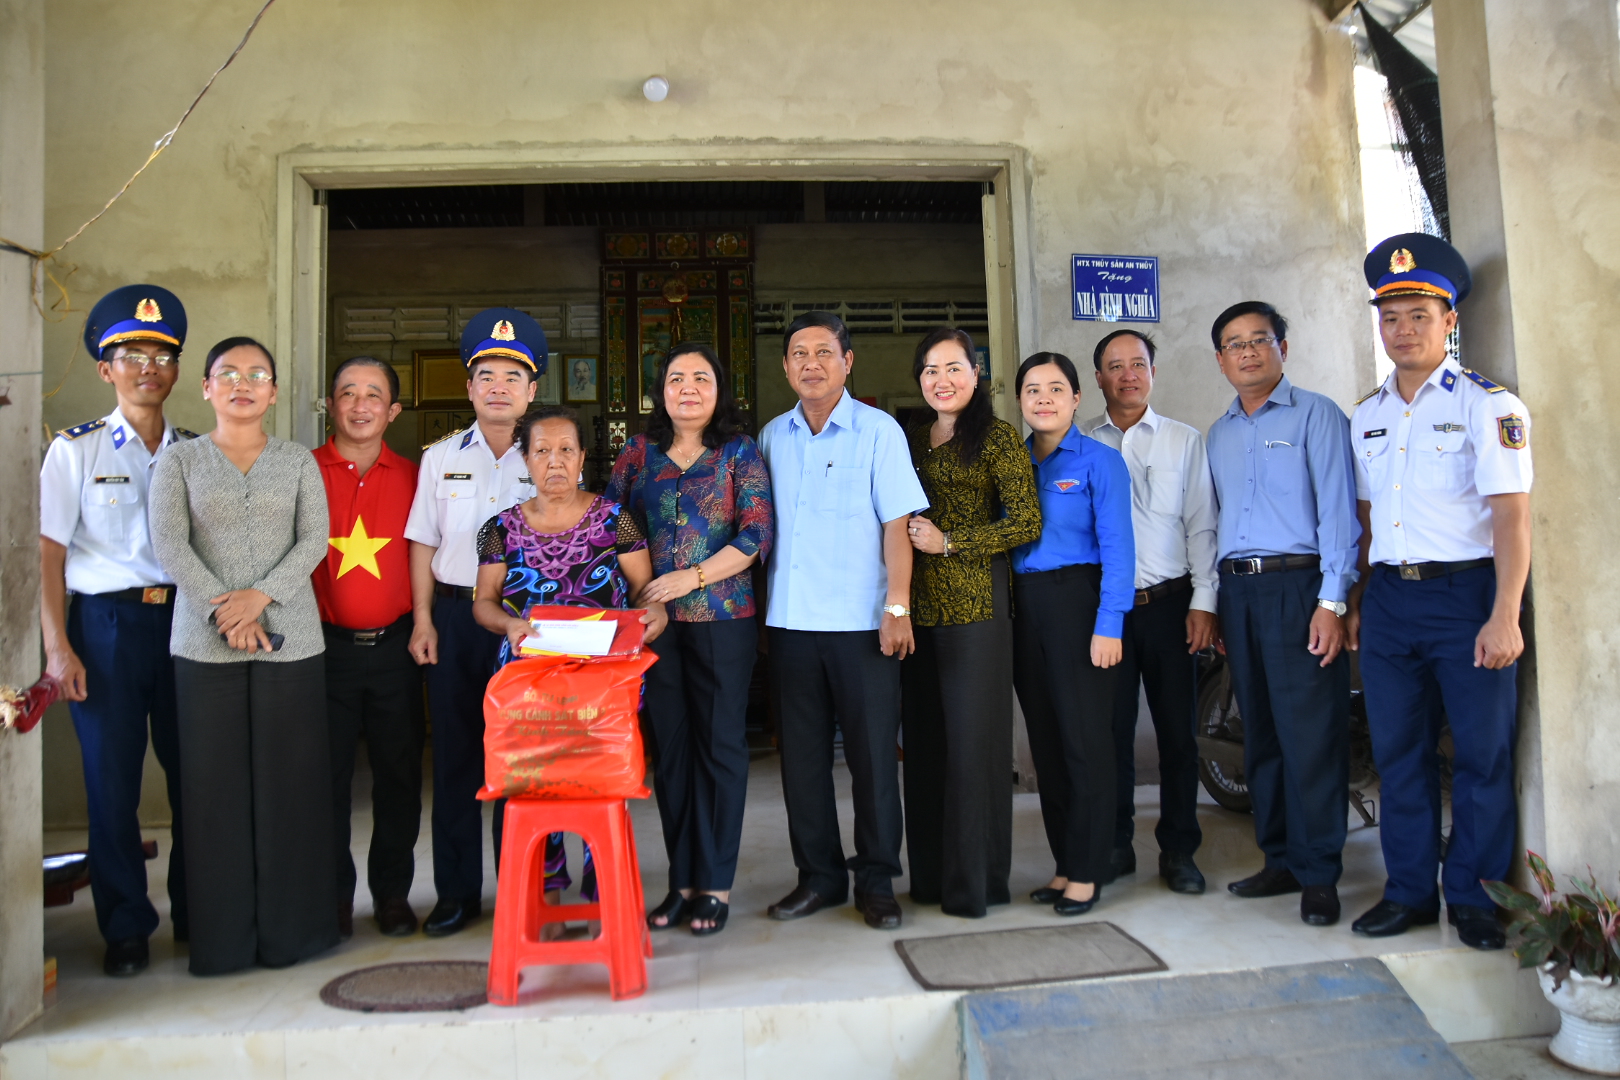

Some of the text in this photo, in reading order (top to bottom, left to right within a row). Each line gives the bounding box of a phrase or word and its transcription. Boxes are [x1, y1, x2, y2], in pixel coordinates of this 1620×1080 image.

[1077, 258, 1153, 270] HTX THỦY SẢN AN THỦY
[1097, 271, 1133, 283] Tặng
[1077, 285, 1155, 317] NHÀ TÌNH NGHĨA
